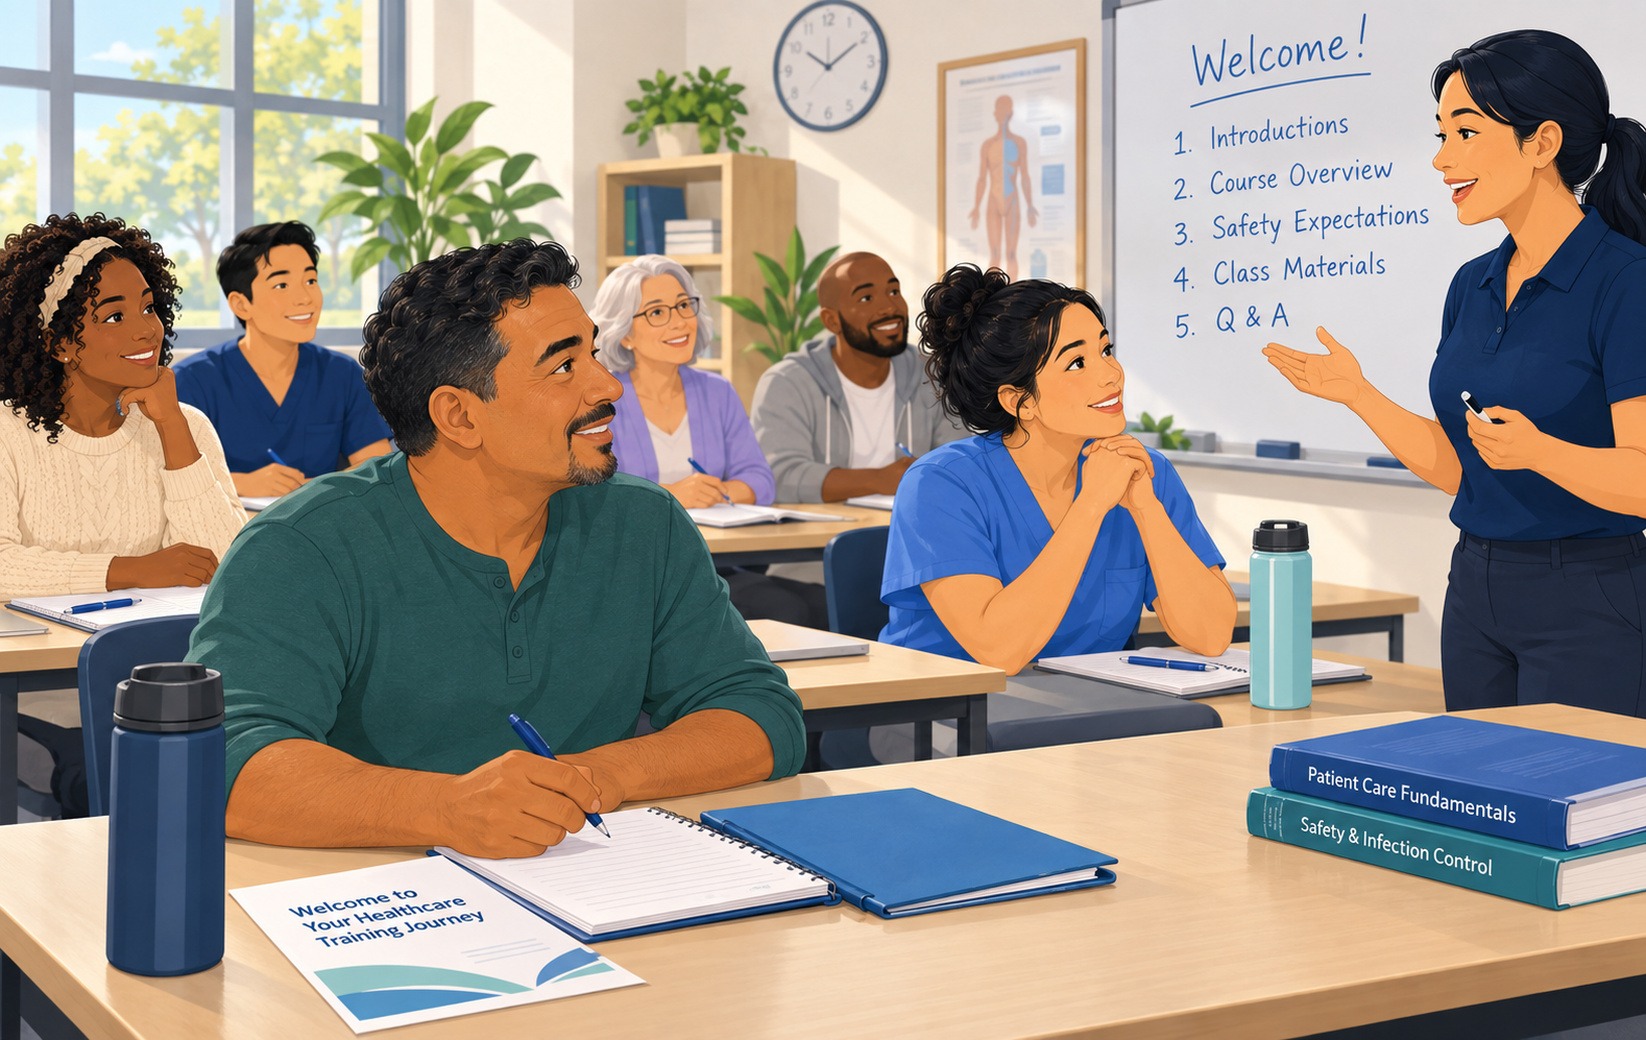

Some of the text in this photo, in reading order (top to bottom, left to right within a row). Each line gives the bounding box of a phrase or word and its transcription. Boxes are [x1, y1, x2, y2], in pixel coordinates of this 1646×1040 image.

[822, 12, 836, 27] 12
[846, 16, 852, 29] 1
[804, 22, 814, 36] 11
[860, 30, 869, 45] 2
[790, 40, 802, 55] 10
[1191, 12, 1367, 87] Welcome!
[866, 54, 876, 69] 3
[784, 64, 793, 78] 9
[790, 86, 799, 100] 8
[860, 80, 868, 93] 4
[805, 101, 813, 117] 7
[824, 106, 833, 120] 6
[845, 99, 854, 113] 5
[1174, 115, 1349, 156] 1. Introductions
[1173, 159, 1393, 201] 2. Course Overview
[1174, 204, 1430, 247] 3. Safety Expectations
[1173, 250, 1386, 293] 4. Class Materials
[1175, 302, 1290, 339] 5. Q & A
[1308, 766, 1517, 824] Patient Care Fundamentals
[1300, 816, 1345, 844] Safety
[1348, 827, 1360, 845] &
[1363, 830, 1429, 861] Infection
[1433, 847, 1493, 876] Control
[288, 889, 418, 918] Welcome to
[302, 897, 467, 933] Your Healthcare
[315, 910, 484, 948] Training Journey
